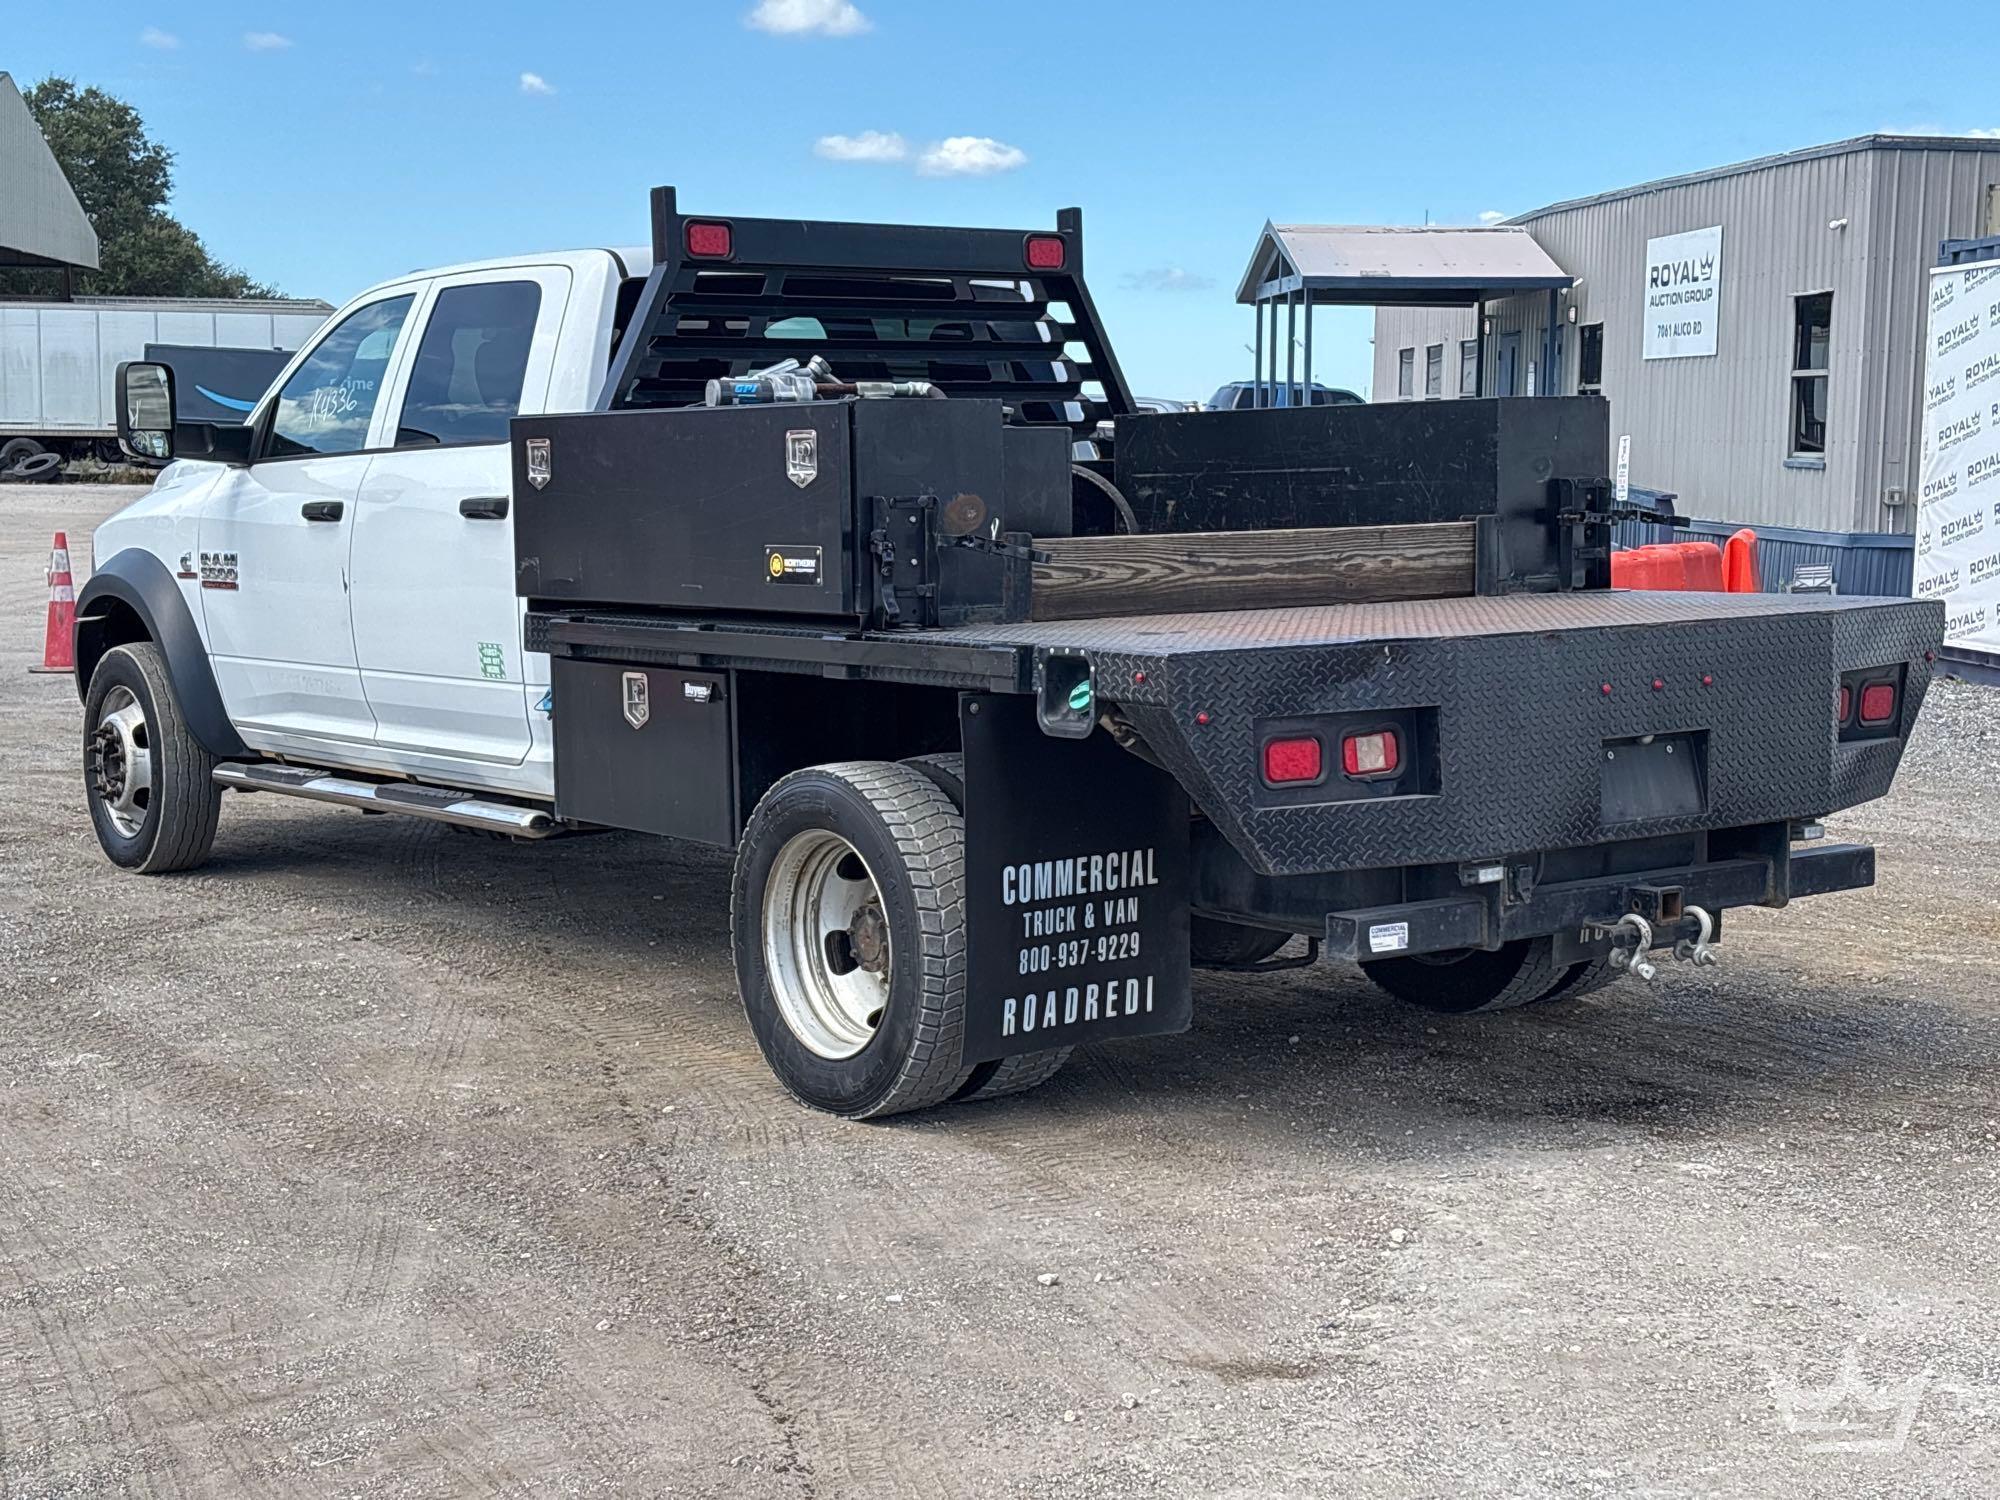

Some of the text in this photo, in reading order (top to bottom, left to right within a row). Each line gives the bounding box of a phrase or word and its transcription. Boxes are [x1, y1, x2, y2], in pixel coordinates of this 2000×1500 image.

[1650, 259, 1699, 289] ROYAL
[1649, 288, 1713, 307] AUCTION GROUP
[1657, 321, 1702, 338] 7061 ALICO RD
[1937, 320, 1970, 348] ROYAL
[1938, 329, 1980, 357] AUCTION GROUP
[1965, 353, 2000, 381] ROYAL
[734, 383, 758, 393] GPI
[1966, 373, 1989, 390] AUCTION
[1938, 391, 1956, 405] GROUP
[1938, 417, 1972, 443] ROYAL
[1939, 426, 1981, 452] AUCTION GROUP
[1967, 452, 2000, 478] ROYAL
[1968, 472, 1991, 488] AUCTION
[1940, 487, 1958, 500] GROUP
[1941, 514, 1974, 538] ROYAL
[1942, 525, 1984, 547] AUCTION GROUP
[200, 553, 238, 567] RAM
[201, 567, 238, 581] 5500
[1919, 572, 1950, 594] ROYAL
[1970, 570, 1994, 585] AUCTION
[1941, 583, 1959, 596] GROUP
[1966, 624, 1985, 636] GROUP
[1003, 848, 1158, 905] COMMERCIAL
[1023, 897, 1138, 938] TRUCK & VAN
[1019, 931, 1140, 976] 800-937-9229
[1002, 975, 1154, 1037] ROADREDI
